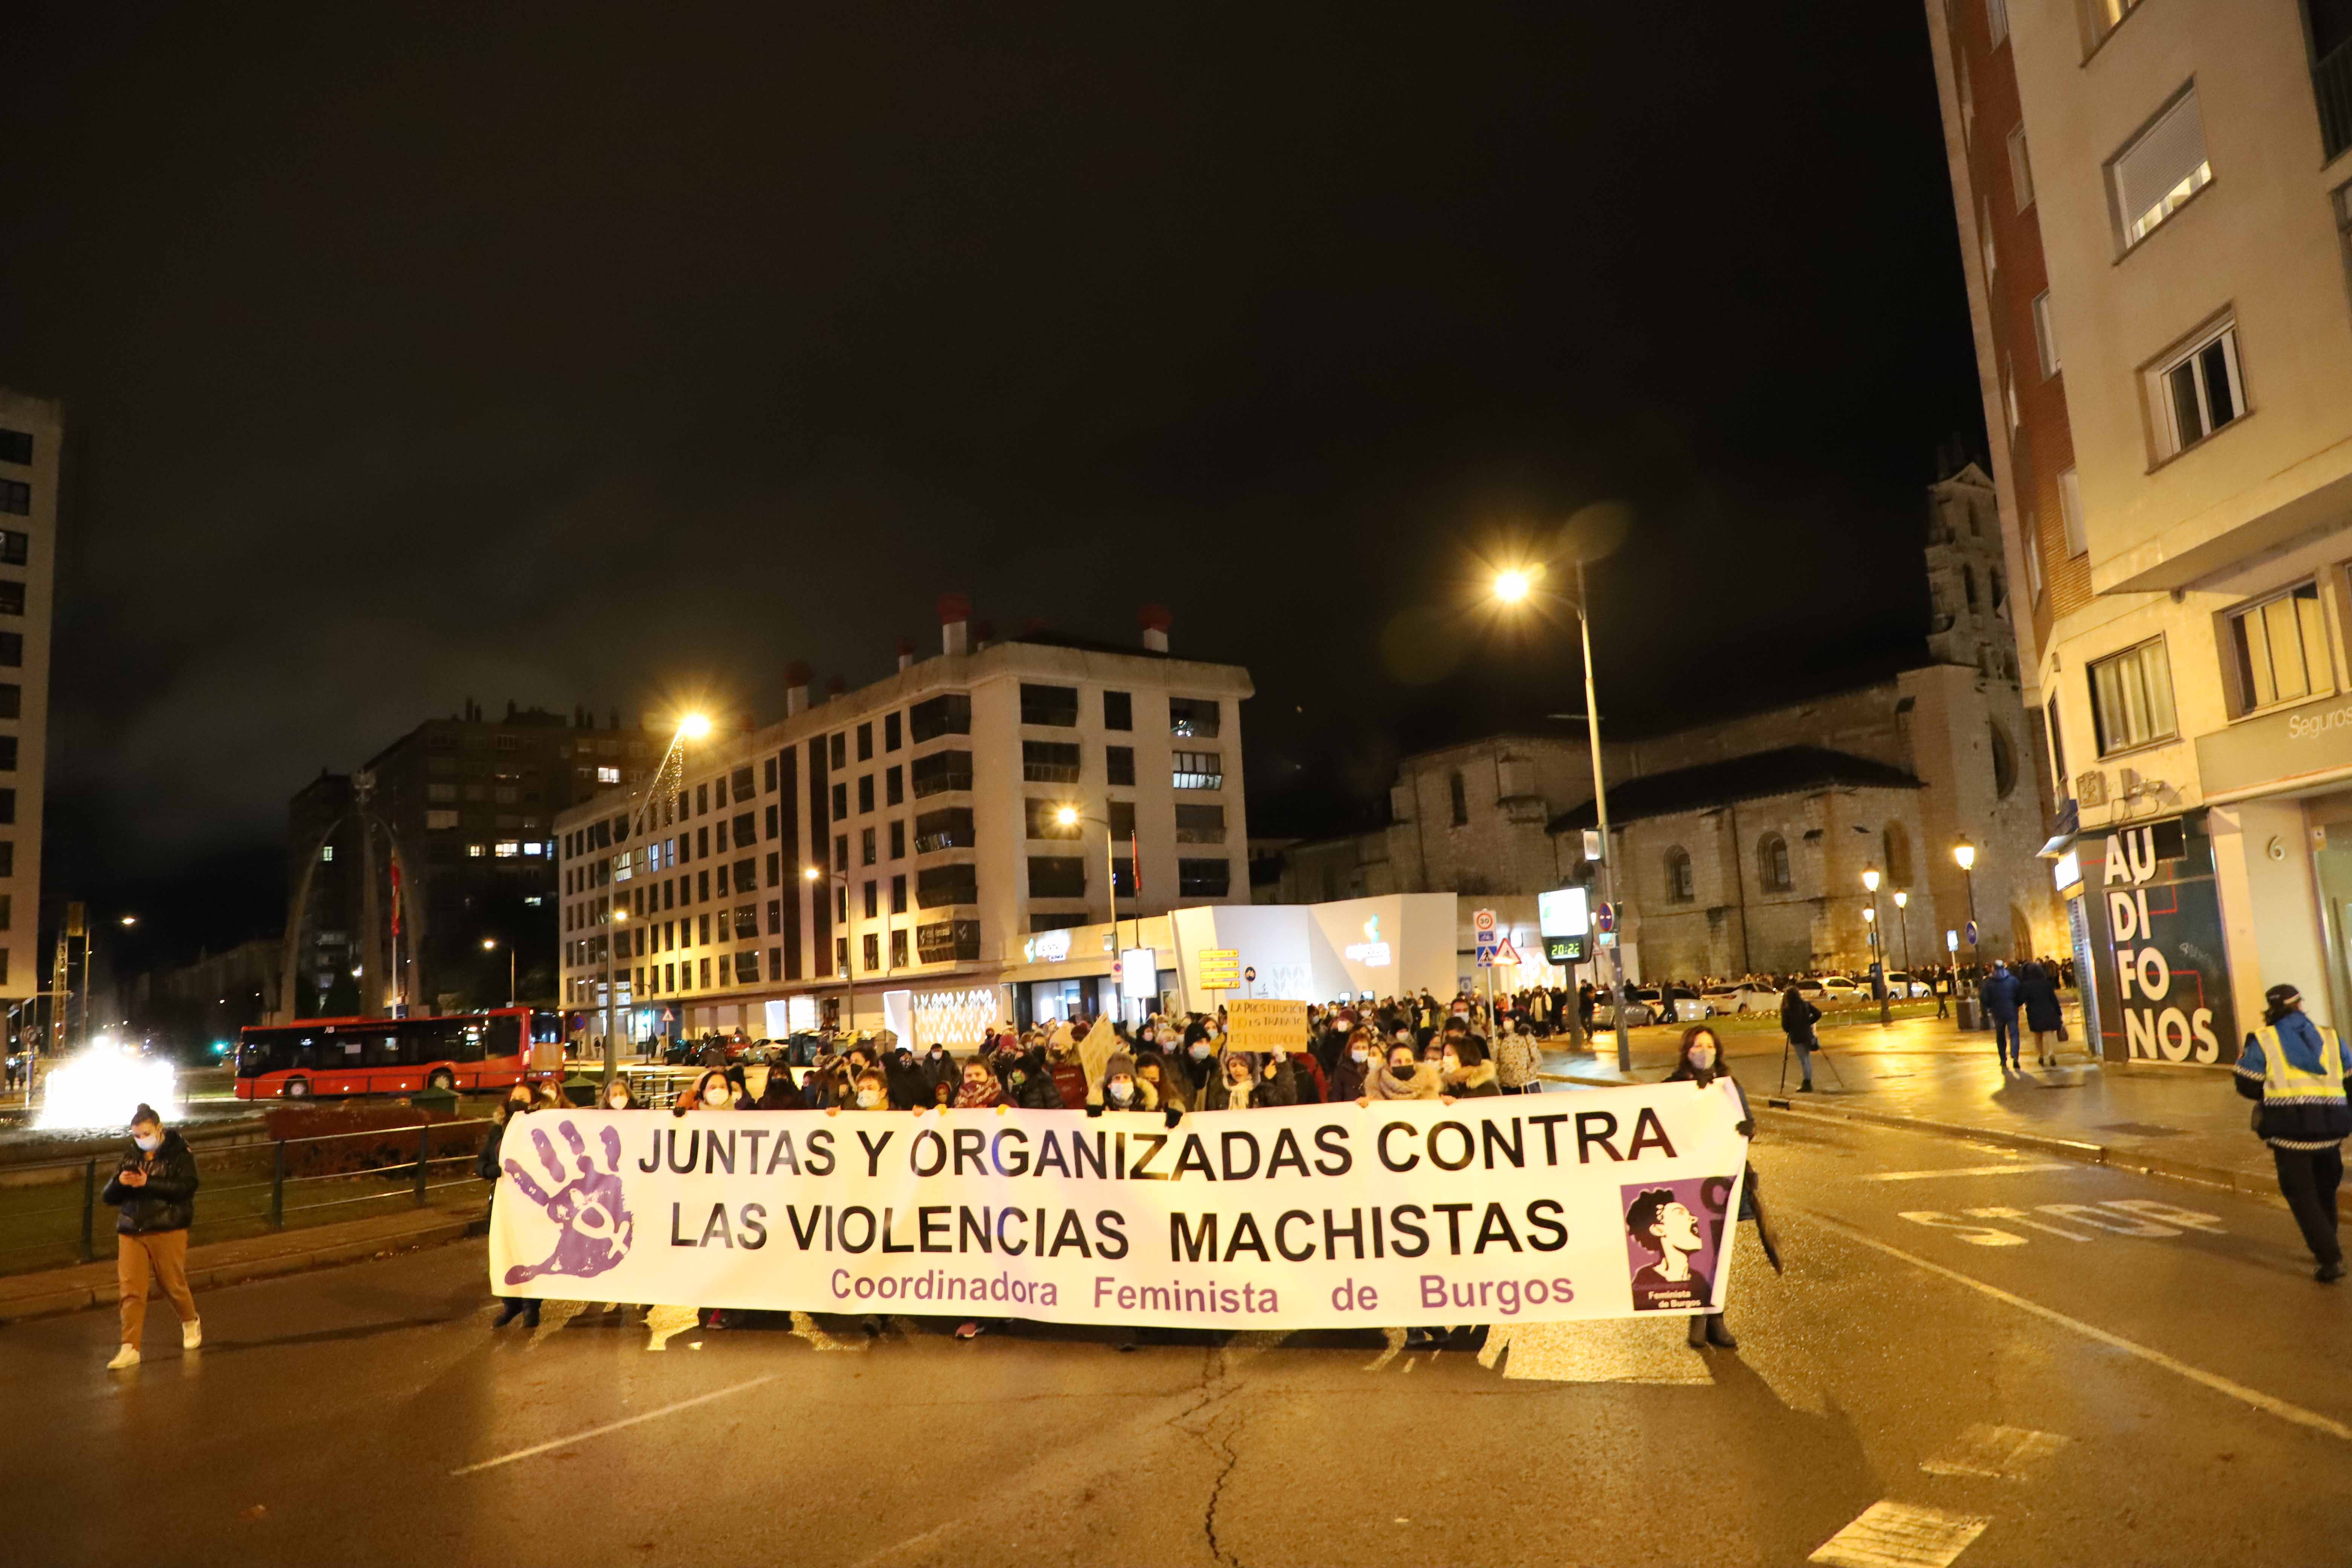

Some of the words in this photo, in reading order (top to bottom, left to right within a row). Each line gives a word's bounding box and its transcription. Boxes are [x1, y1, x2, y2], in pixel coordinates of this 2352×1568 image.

[2289, 706, 2352, 738] Seguros
[2104, 826, 2156, 886] AU
[2267, 835, 2286, 861] 6
[2110, 889, 2152, 942] DI
[2117, 946, 2170, 1001] FO
[1230, 1002, 1242, 1012] LA
[2125, 1007, 2219, 1064] NOS
[639, 1129, 835, 1176] JUNTAS
[856, 1131, 894, 1177] Y
[910, 1125, 1352, 1181] ORGANIZADAS
[1377, 1107, 1678, 1173] CONTRA
[671, 1202, 767, 1250] LAS
[787, 1205, 1129, 1259] VIOLENCIAS
[1170, 1199, 1568, 1262] MACHISTAS
[1898, 1199, 2228, 1246] STOP
[831, 1268, 1058, 1306] Coordinadora
[1094, 1277, 1279, 1313] Feminista
[1332, 1278, 1378, 1311] de
[1420, 1275, 1575, 1315] Burgos
[1648, 1290, 1691, 1300] Feminista
[1670, 1299, 1701, 1308] Burgos
